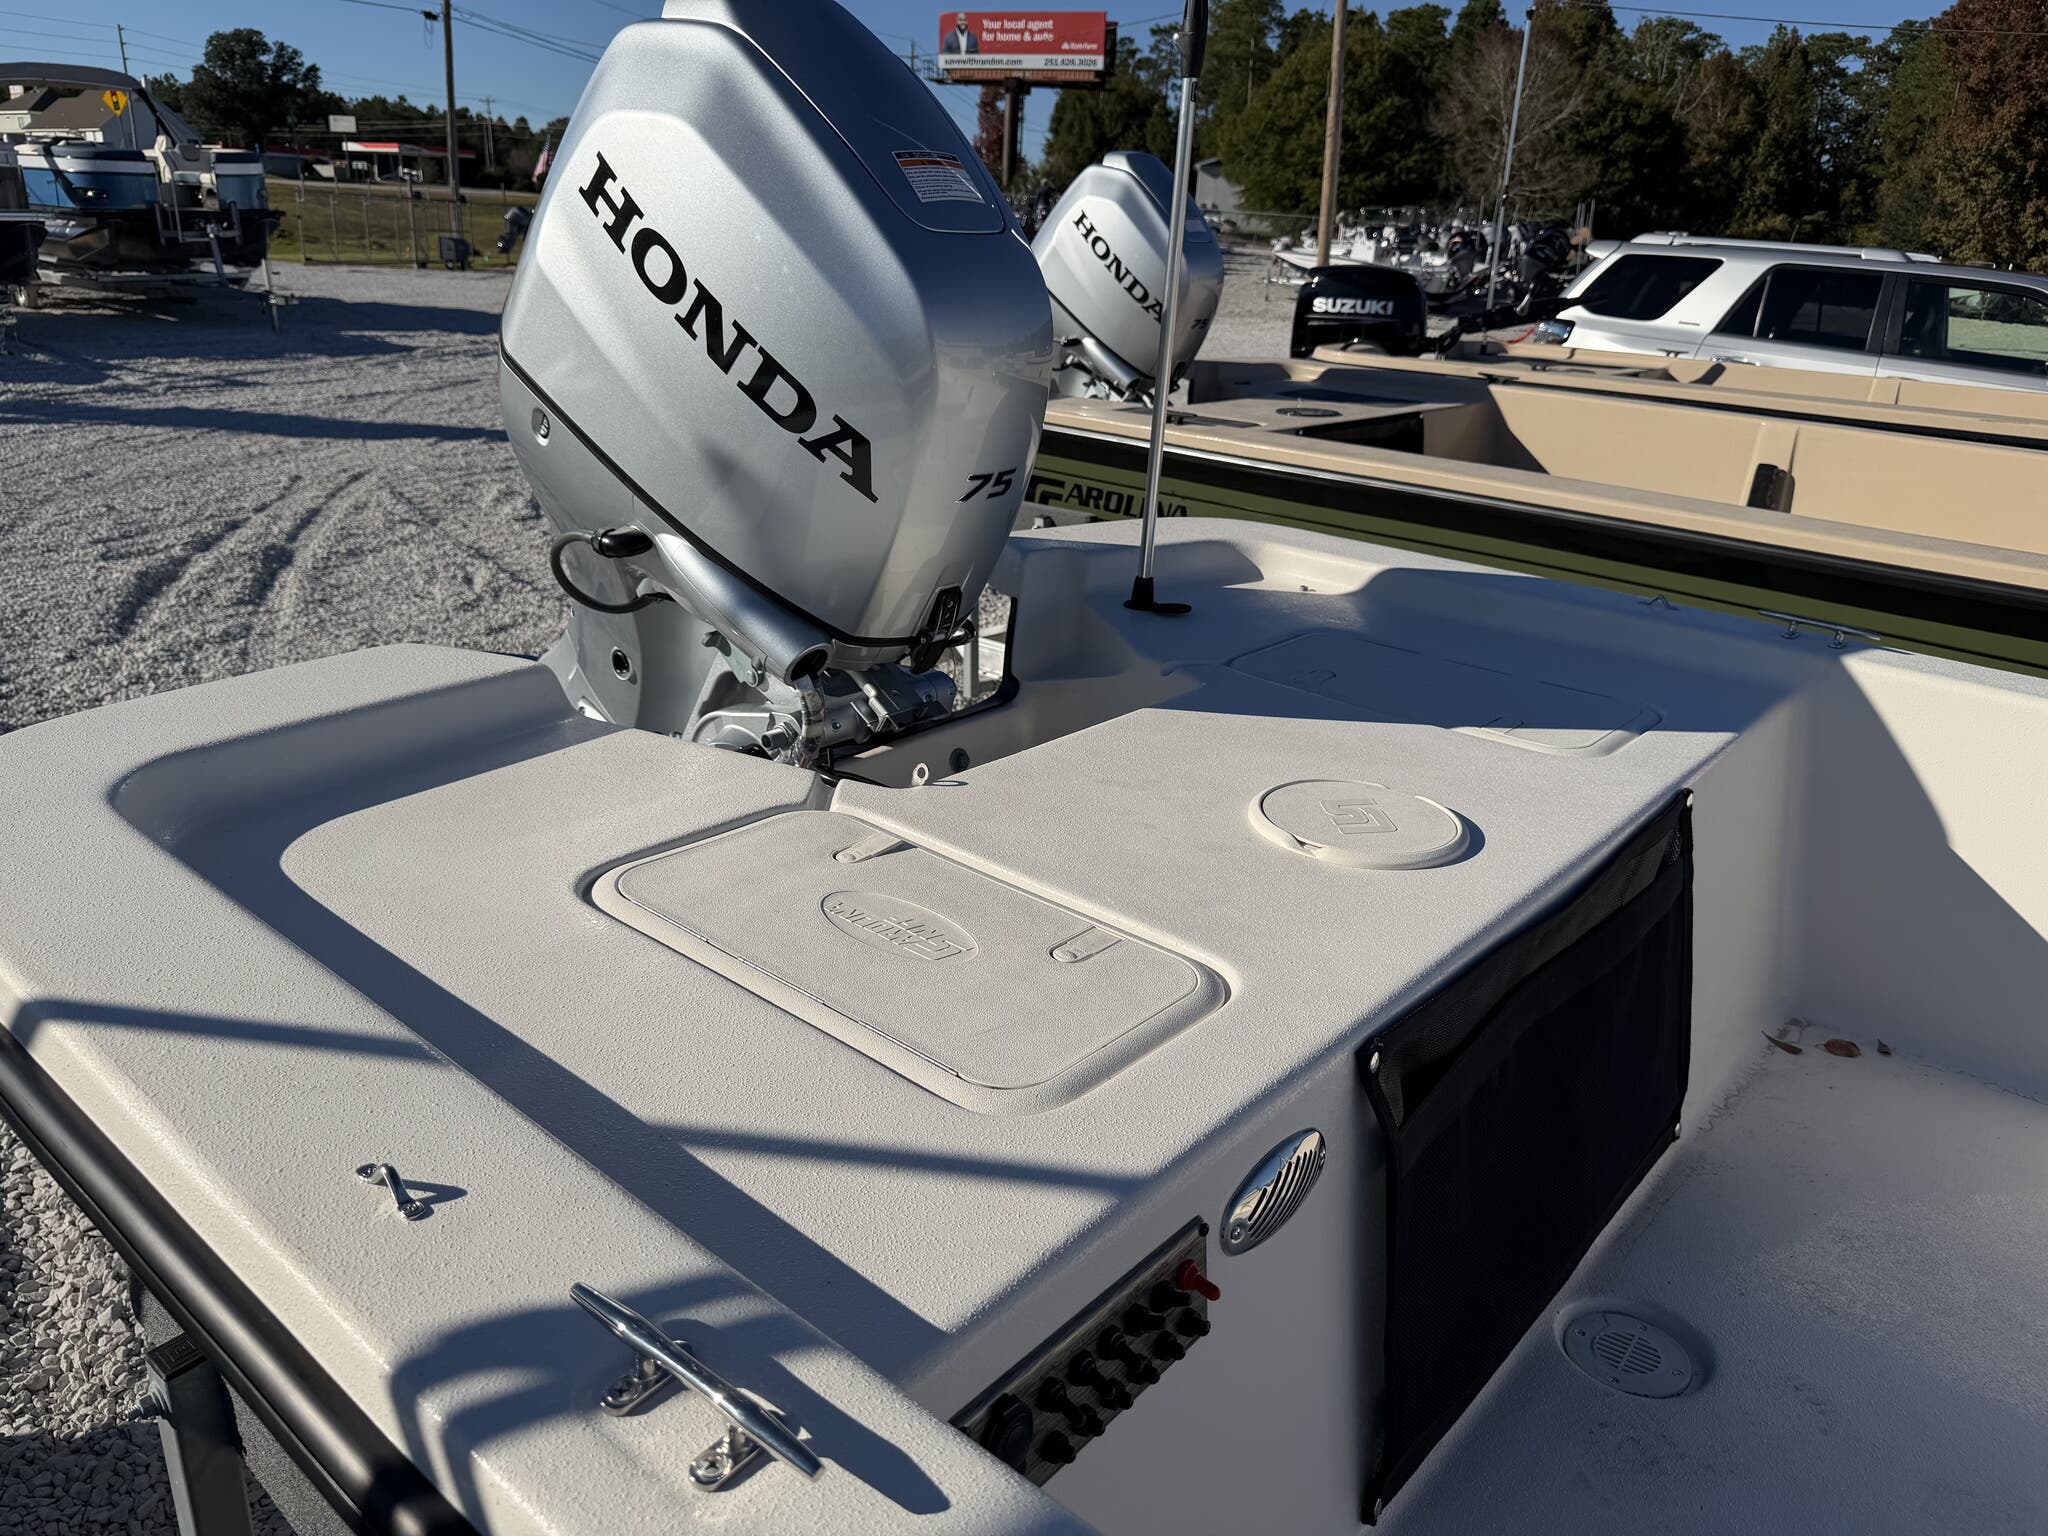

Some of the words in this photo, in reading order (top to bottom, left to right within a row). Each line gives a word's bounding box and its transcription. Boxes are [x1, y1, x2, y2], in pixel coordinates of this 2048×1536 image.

[982, 19, 1002, 29] Your
[1003, 19, 1026, 29] local
[1027, 19, 1054, 31] agent
[982, 31, 995, 42] for
[996, 31, 1022, 42] home
[1023, 31, 1032, 42] &
[1033, 32, 1054, 42] auto
[1072, 209, 1164, 324] HONDA
[1312, 296, 1394, 316] SUZUKI
[578, 150, 879, 504] HONDA
[954, 467, 1017, 504] 75
